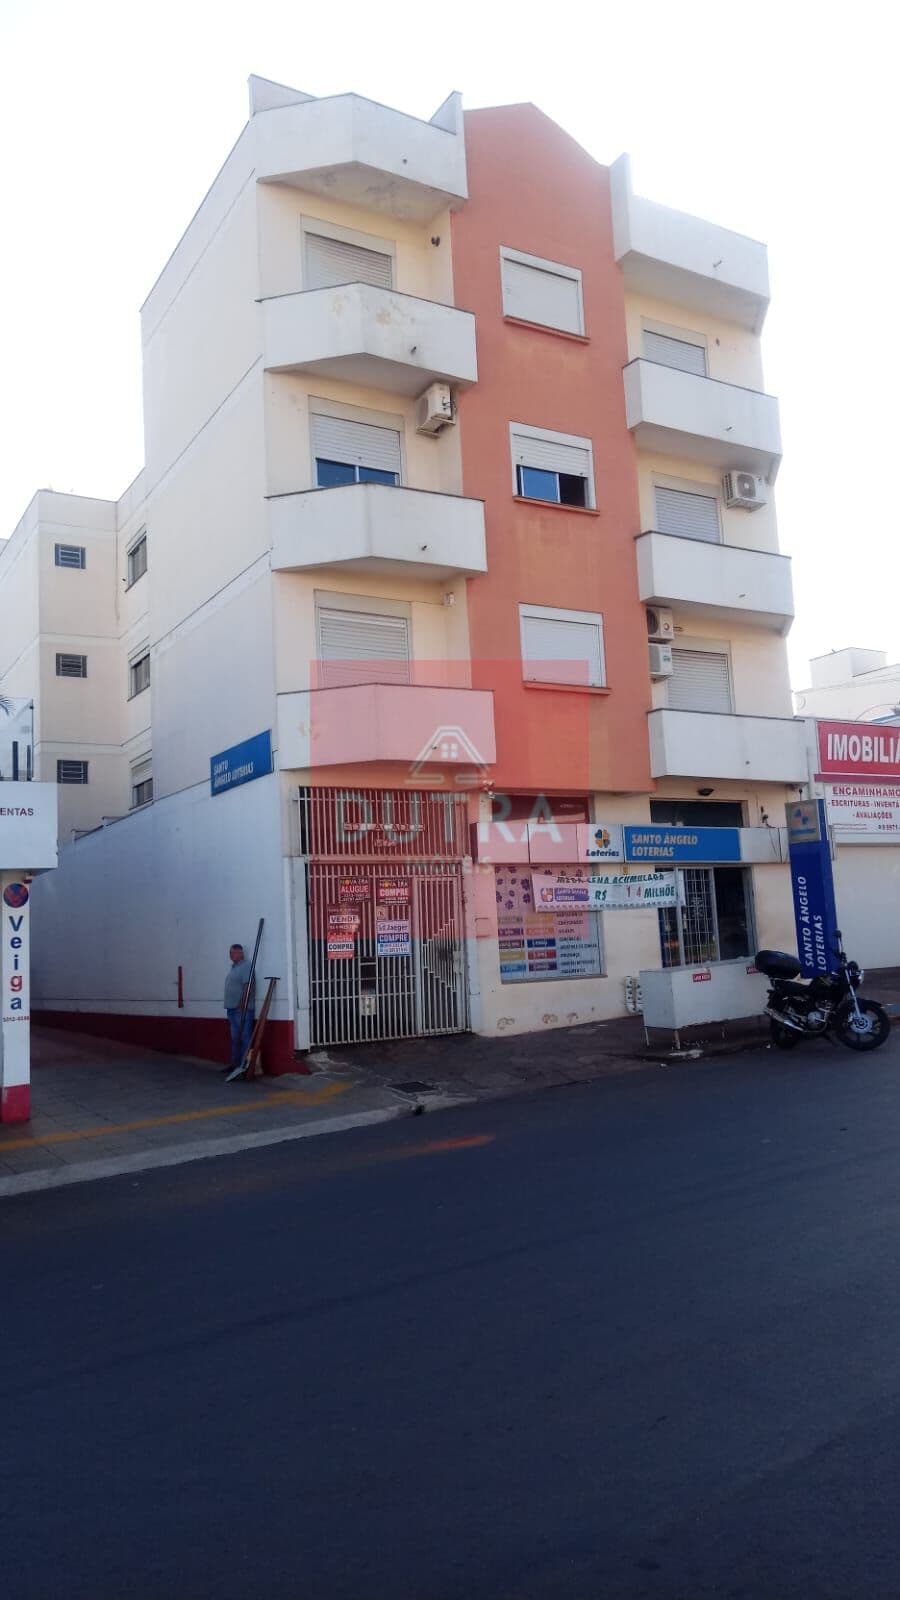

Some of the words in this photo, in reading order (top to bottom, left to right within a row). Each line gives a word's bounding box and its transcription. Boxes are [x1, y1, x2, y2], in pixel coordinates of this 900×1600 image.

[0, 807, 34, 817] ENTAS
[631, 833, 662, 845] SANTO
[664, 831, 698, 846] ÂNGELO
[586, 849, 620, 857] Loterias
[632, 846, 675, 857] LOTERIAS
[341, 885, 369, 893] ALUGUE
[379, 888, 409, 897] COMPRE
[594, 890, 607, 901] R$
[797, 876, 811, 924] ÂNGELO
[380, 933, 408, 941] COMPRE
[813, 914, 828, 971] LOTERIAS
[328, 943, 354, 951] COMPRE
[804, 928, 815, 968] SANTO
[9, 914, 24, 1011] Veiga
